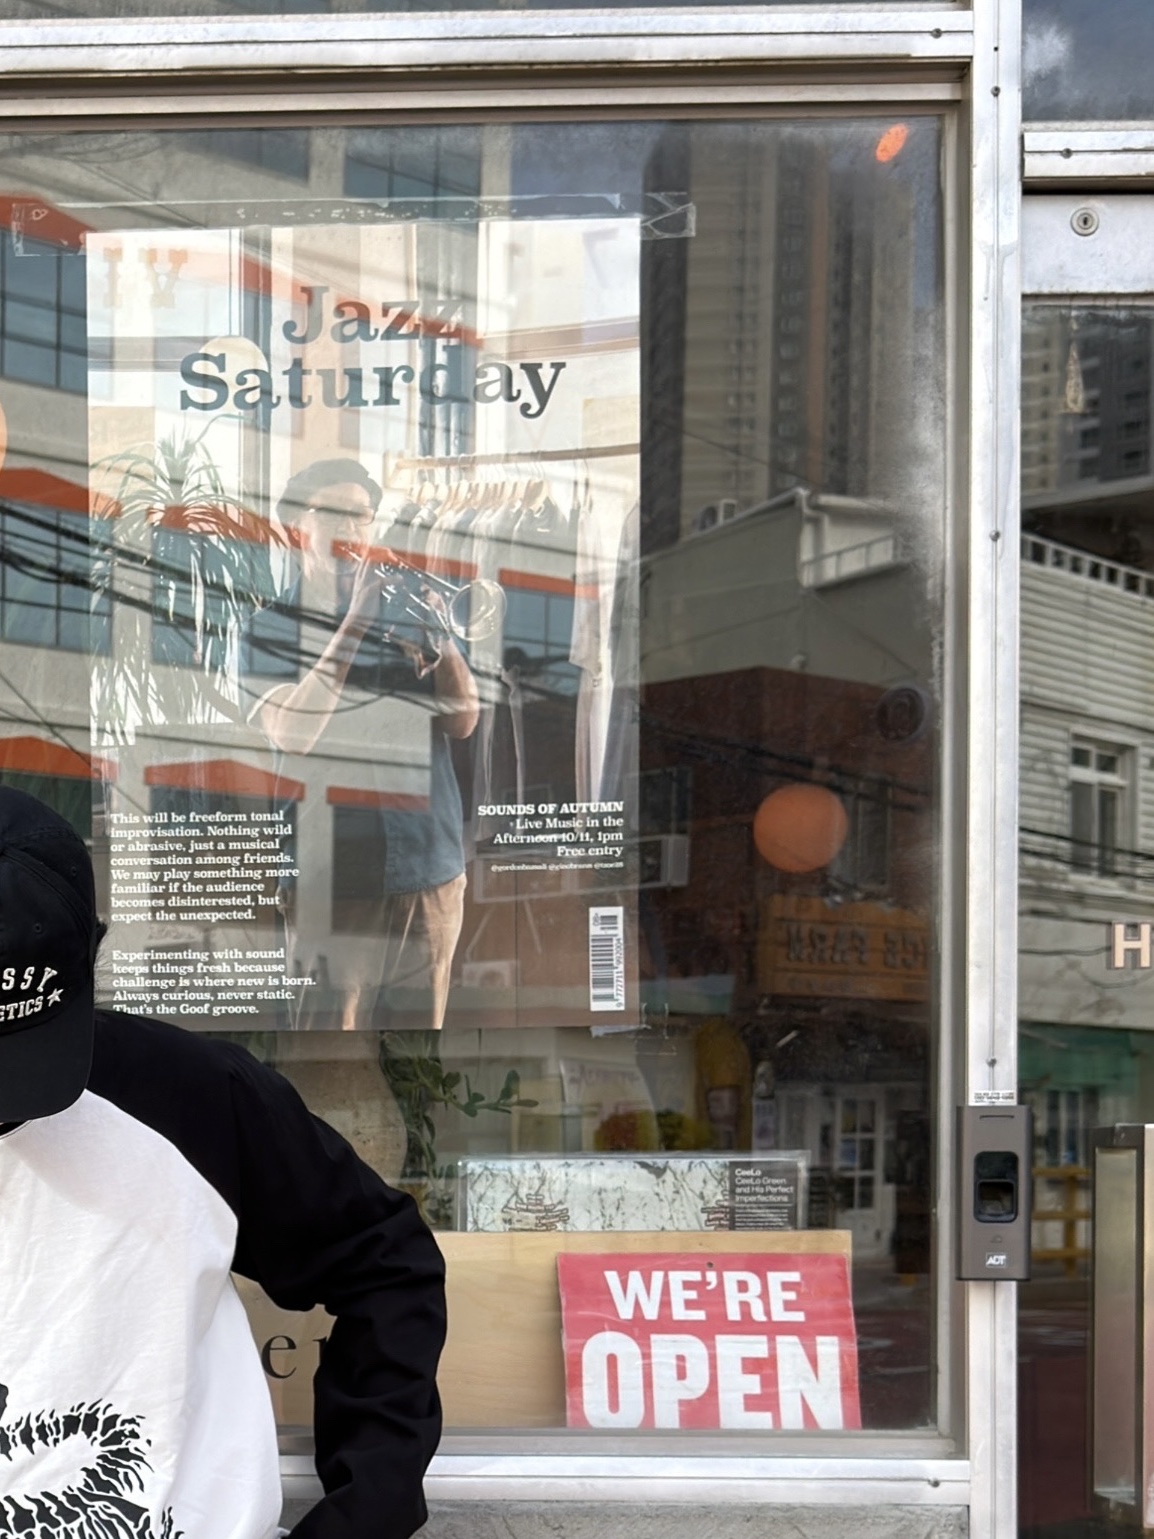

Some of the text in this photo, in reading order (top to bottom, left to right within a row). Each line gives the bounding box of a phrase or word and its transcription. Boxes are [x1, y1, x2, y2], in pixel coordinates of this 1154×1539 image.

[282, 285, 468, 345] Jazz
[179, 344, 568, 419] Saturday
[478, 801, 623, 815] SOUNDS OF AUTUMN
[111, 810, 284, 824] This will be freeform tonal
[516, 816, 623, 829] Live Music in the
[111, 825, 292, 840] improvisation. Nothing wild
[493, 833, 557, 843] Afternoon
[597, 832, 623, 843] 1pm
[111, 843, 125, 852] or
[128, 841, 186, 852] abrasive,
[189, 841, 214, 853] just
[229, 839, 279, 849] musical
[557, 846, 623, 857] Free entry
[111, 853, 294, 866] conversation among friends.
[111, 868, 299, 882] We may play something more
[111, 882, 264, 894] familiar if the audience
[111, 895, 280, 908] becomes disinterested, but
[111, 910, 256, 923] expect the unexpected.
[112, 948, 284, 961] Experimenting with sound
[112, 963, 284, 975] keeps things fresh because
[112, 976, 316, 988] challenge is where new is born.
[113, 990, 295, 1002] Always curious, never static.
[156, 1004, 176, 1014] the
[180, 1004, 209, 1014] Goof
[213, 1005, 259, 1016] groove.
[735, 1168, 762, 1176] CeeLo
[735, 1176, 787, 1185] CeeLo Green
[765, 1185, 794, 1193] Perfect
[986, 1254, 1007, 1266] ADT
[603, 1269, 807, 1323] WE'RE
[580, 1330, 845, 1430] OPEN
